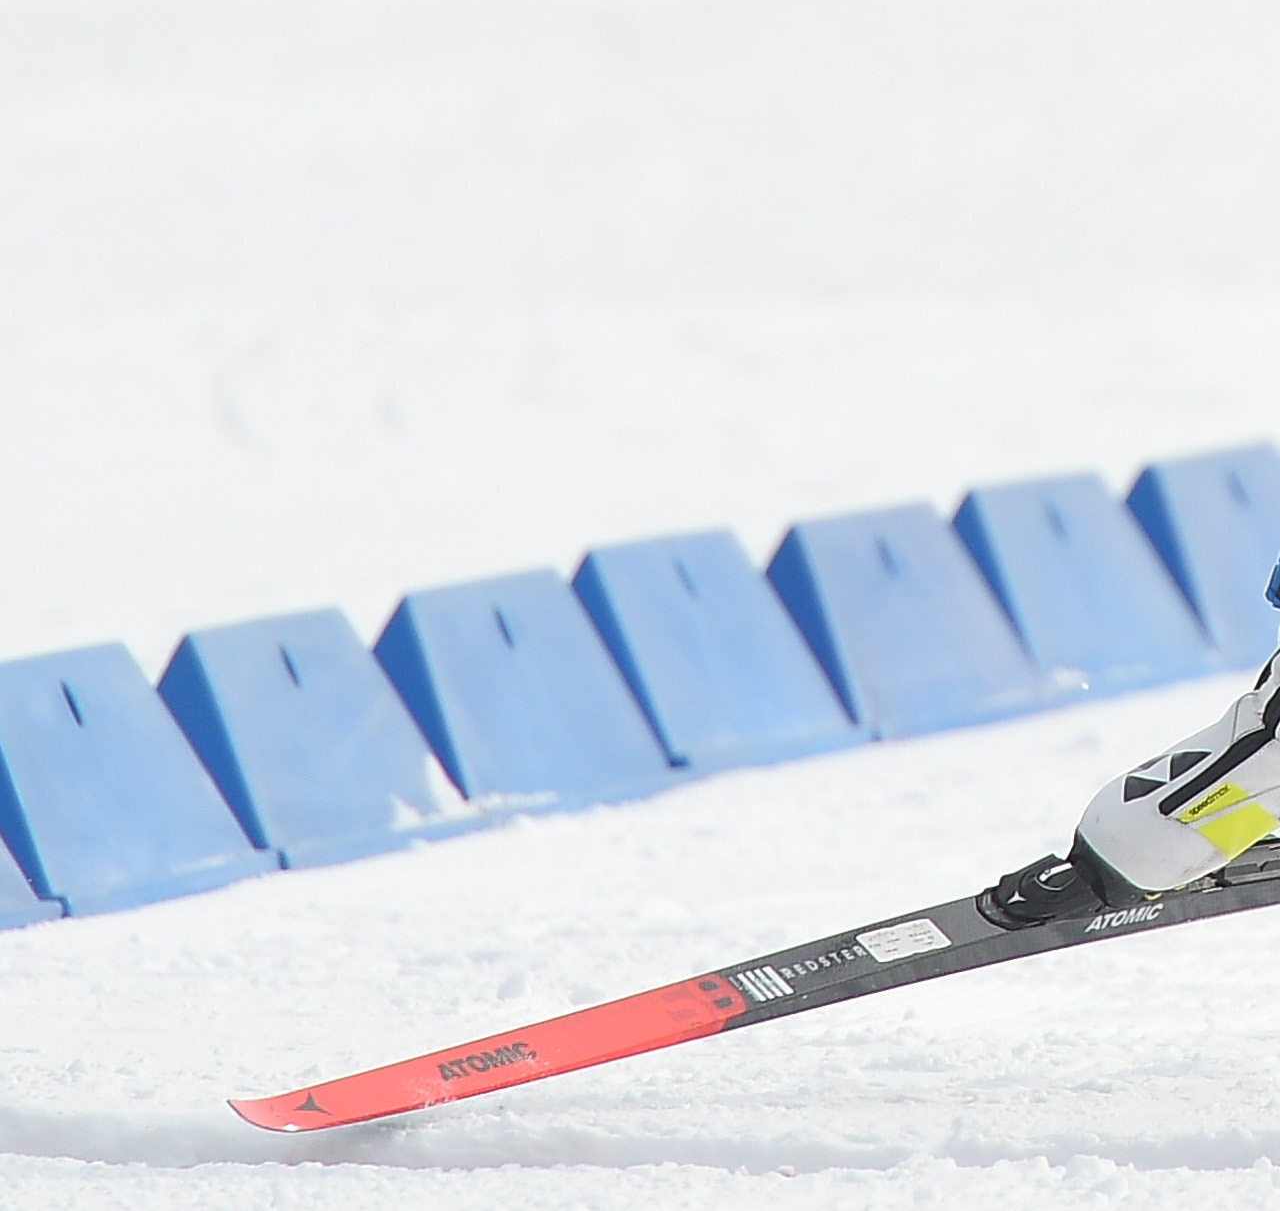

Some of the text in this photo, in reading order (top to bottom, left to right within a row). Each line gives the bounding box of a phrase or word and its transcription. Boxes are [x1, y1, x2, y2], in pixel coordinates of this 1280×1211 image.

[1084, 902, 1164, 934] ATOMIC
[781, 944, 868, 981] REDSTER
[437, 1041, 537, 1082] ATOMIC
